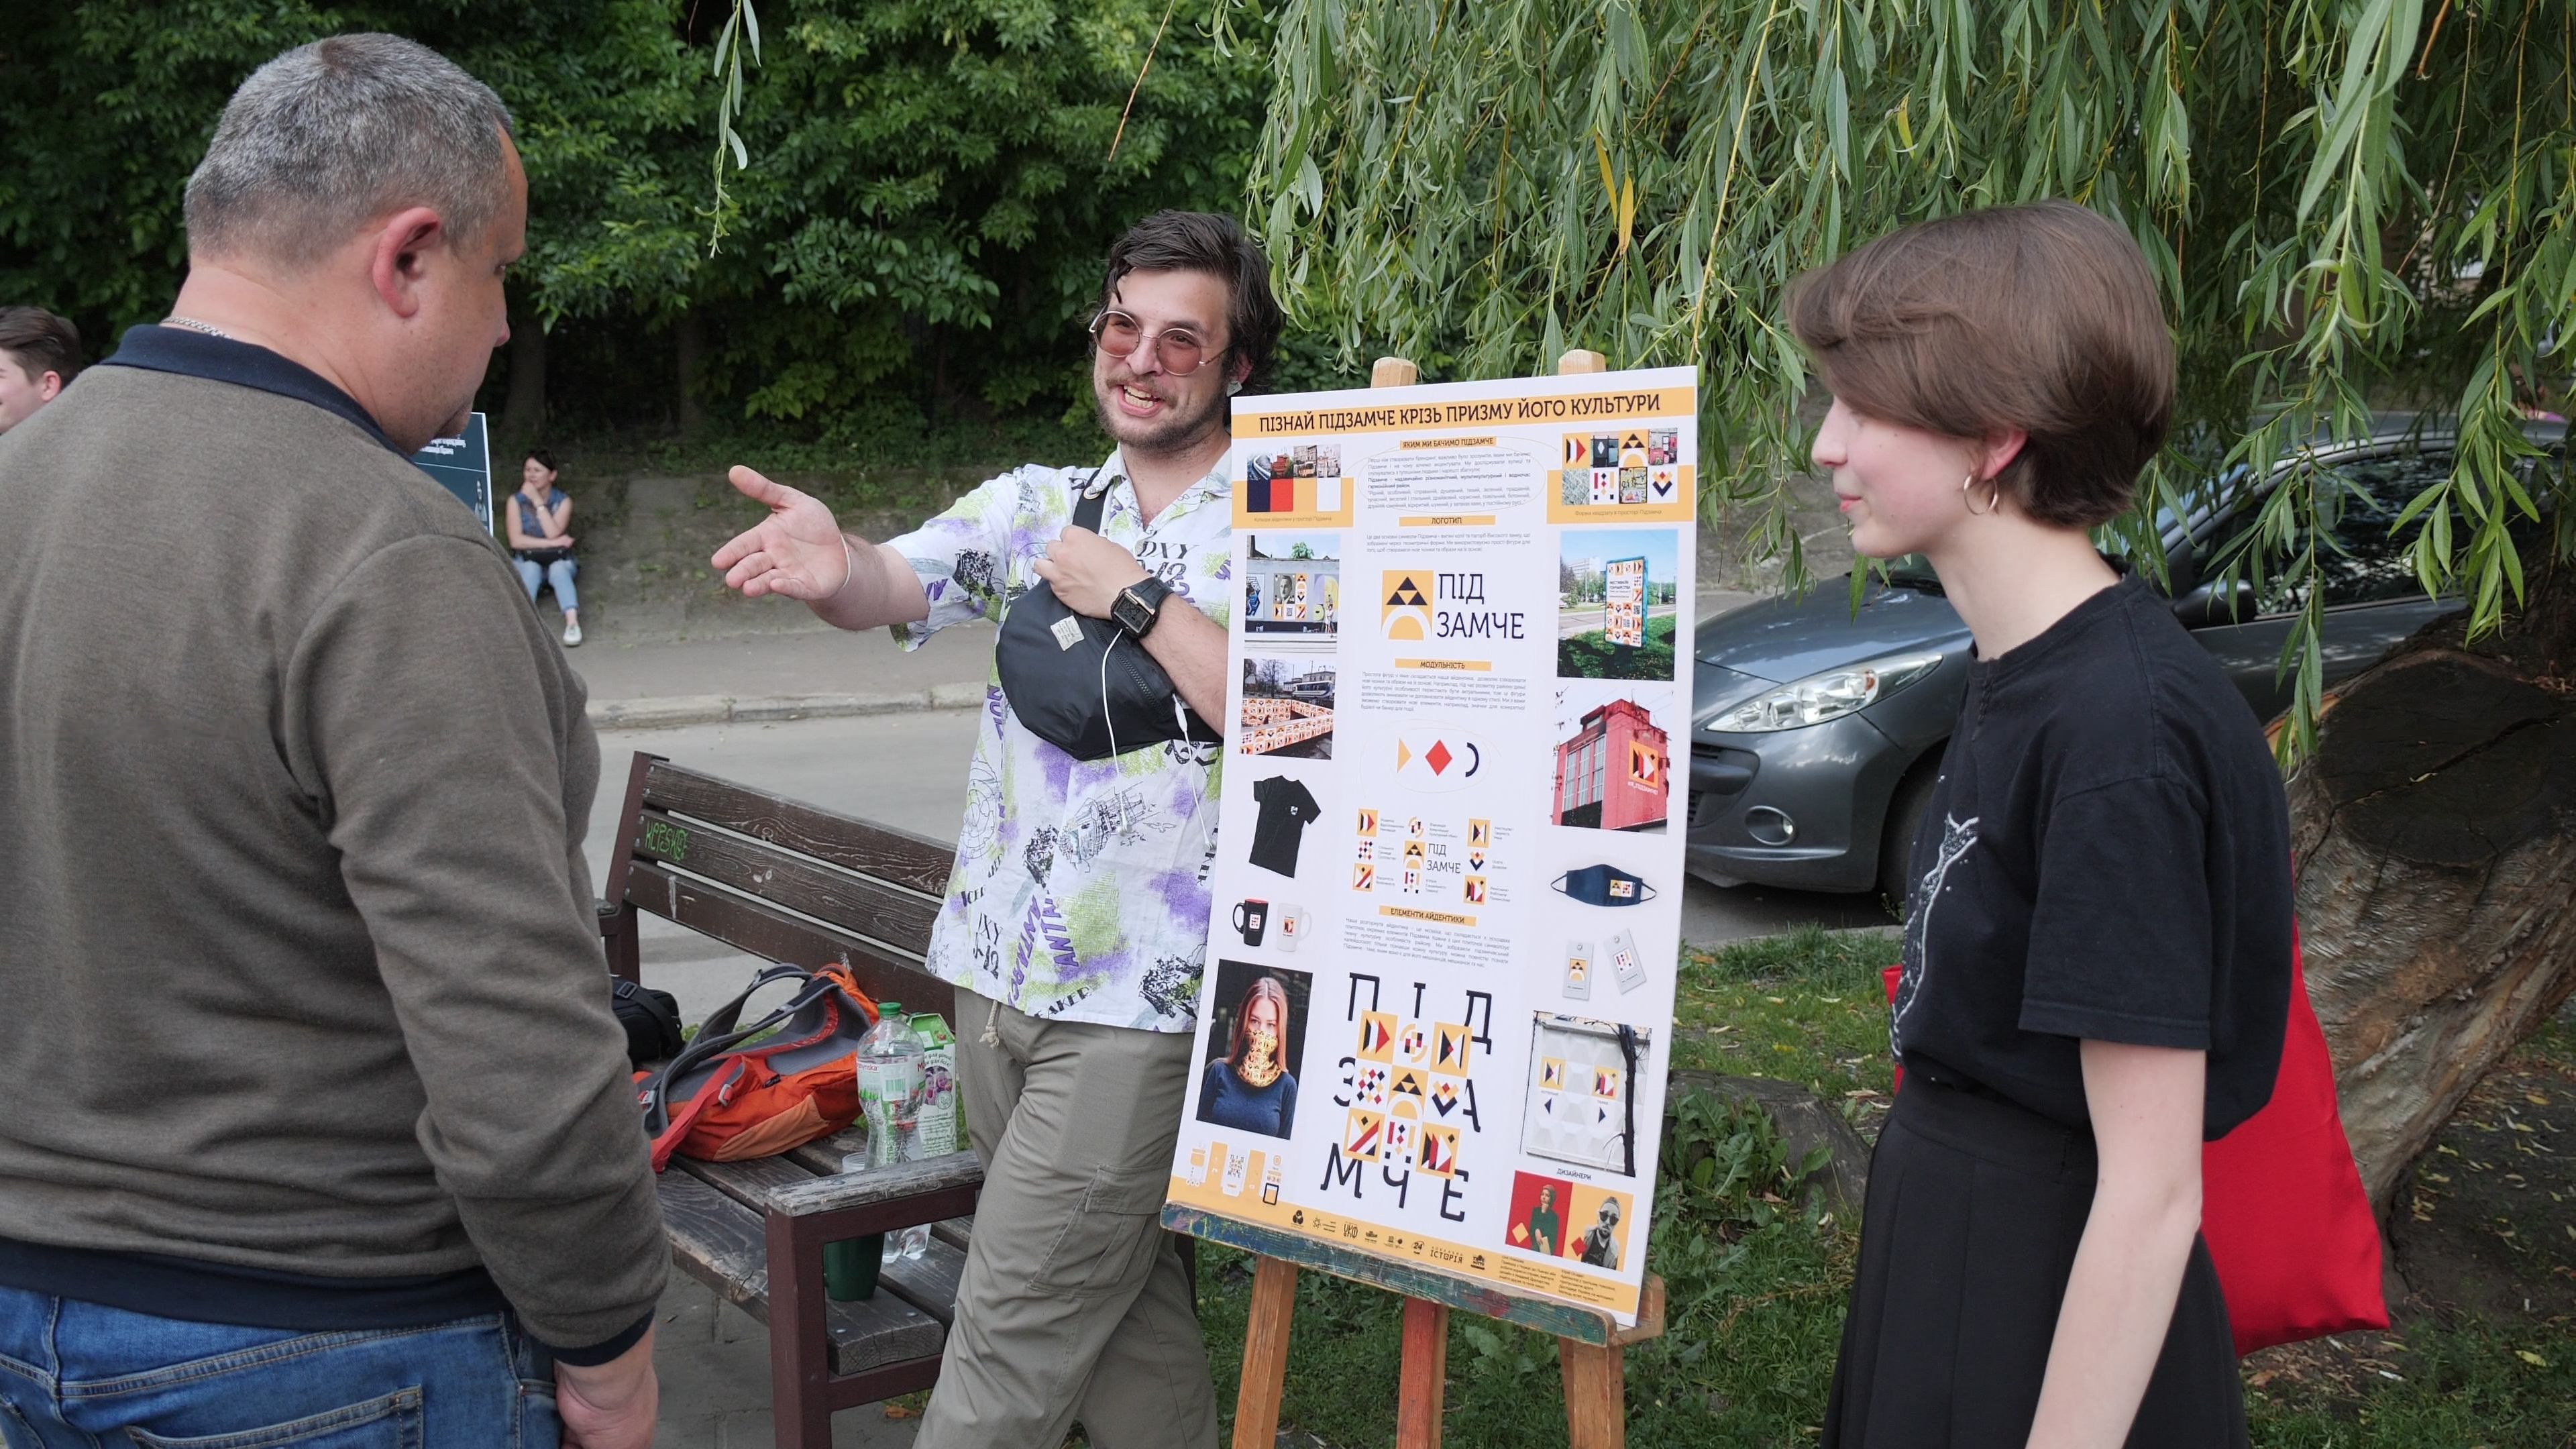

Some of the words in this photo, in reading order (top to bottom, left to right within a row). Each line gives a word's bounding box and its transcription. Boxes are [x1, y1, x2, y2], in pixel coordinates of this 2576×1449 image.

[1260, 411, 1315, 432] ПІЗНАЙ
[1320, 410, 1395, 431] ПІДЗАМЧЕ
[1400, 407, 1442, 425] КРІЗЬ
[1446, 402, 1513, 422] ПРИЗМУ
[1518, 398, 1566, 419] ЙОГО
[1571, 394, 1660, 415] КУЛЬТУРИ
[1434, 439, 1460, 447] БАЧИМО
[1461, 437, 1494, 447] ПІДЗАМЧЕ
[1439, 574, 1485, 605] ПІД
[1436, 611, 1524, 639] ЗАМЧЕ
[1420, 661, 1466, 670] МОДУЛЬНІСТЬ
[1428, 843, 1446, 857] ПІД
[1427, 860, 1461, 874] ЗАМЧЕ
[1391, 908, 1424, 918] ЕЛЕМЕНТИ
[1426, 912, 1464, 924] АЙДЕНТИКИ
[1556, 1167, 1591, 1181] ДИЗАЙНЕРИ
[1413, 1241, 1424, 1250] 24
[1430, 1250, 1463, 1264] ІСТОРІЯ
